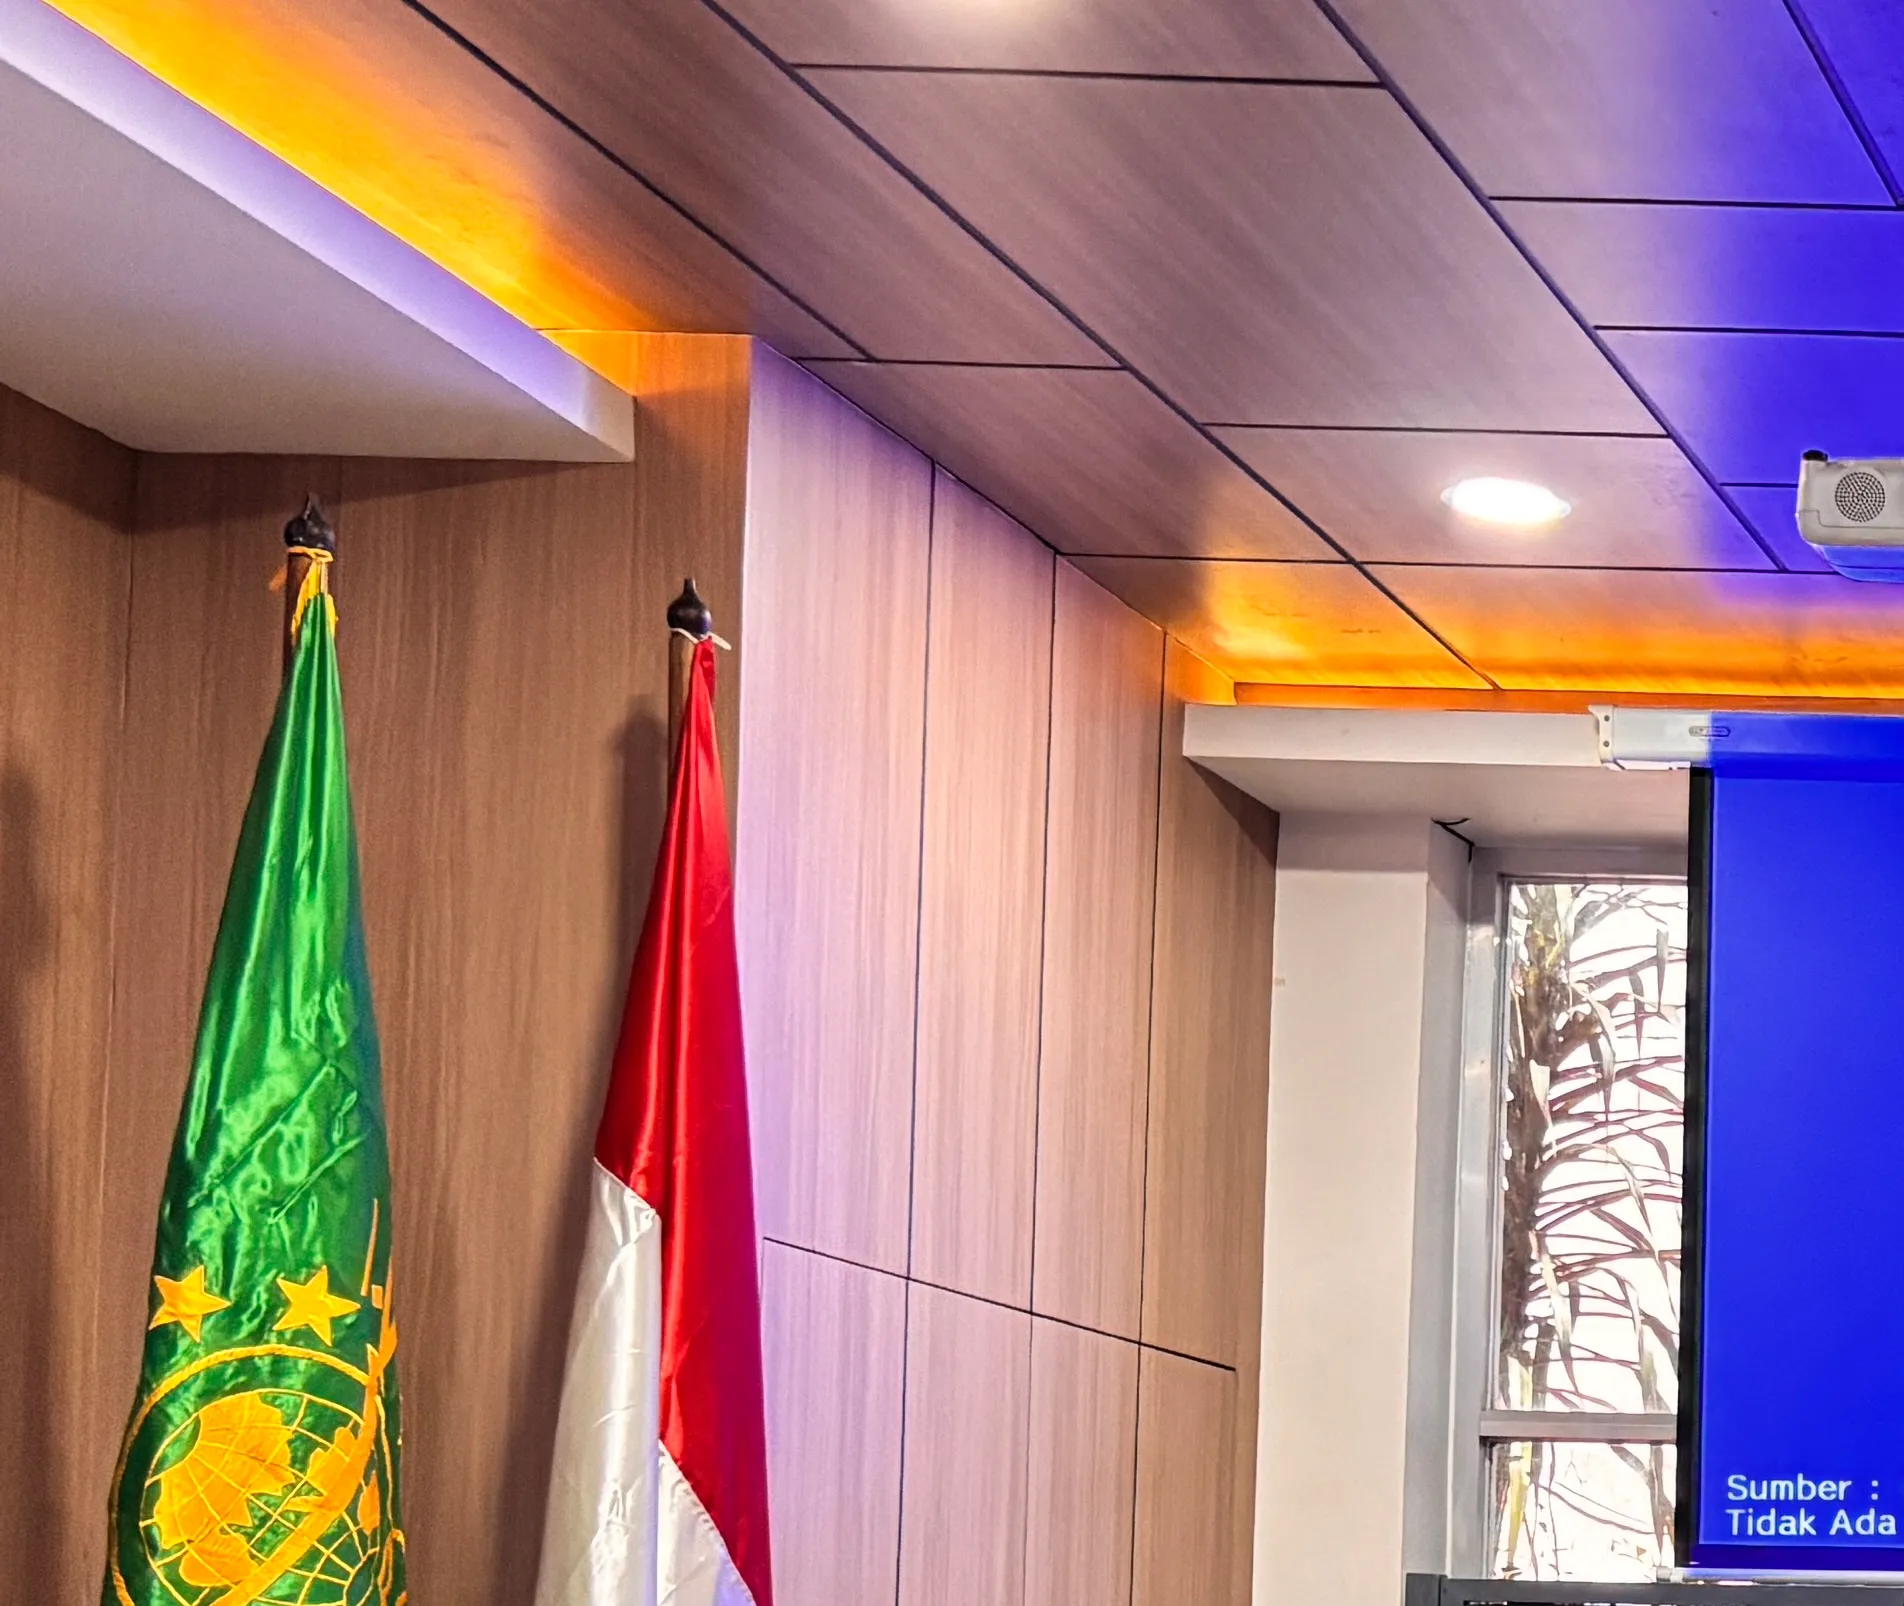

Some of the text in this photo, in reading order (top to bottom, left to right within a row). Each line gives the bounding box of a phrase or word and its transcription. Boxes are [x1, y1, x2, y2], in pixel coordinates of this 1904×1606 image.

[1727, 1473, 1852, 1501] Sumber
[1725, 1507, 1816, 1536] Tidak
[1829, 1507, 1896, 1535] Ada
